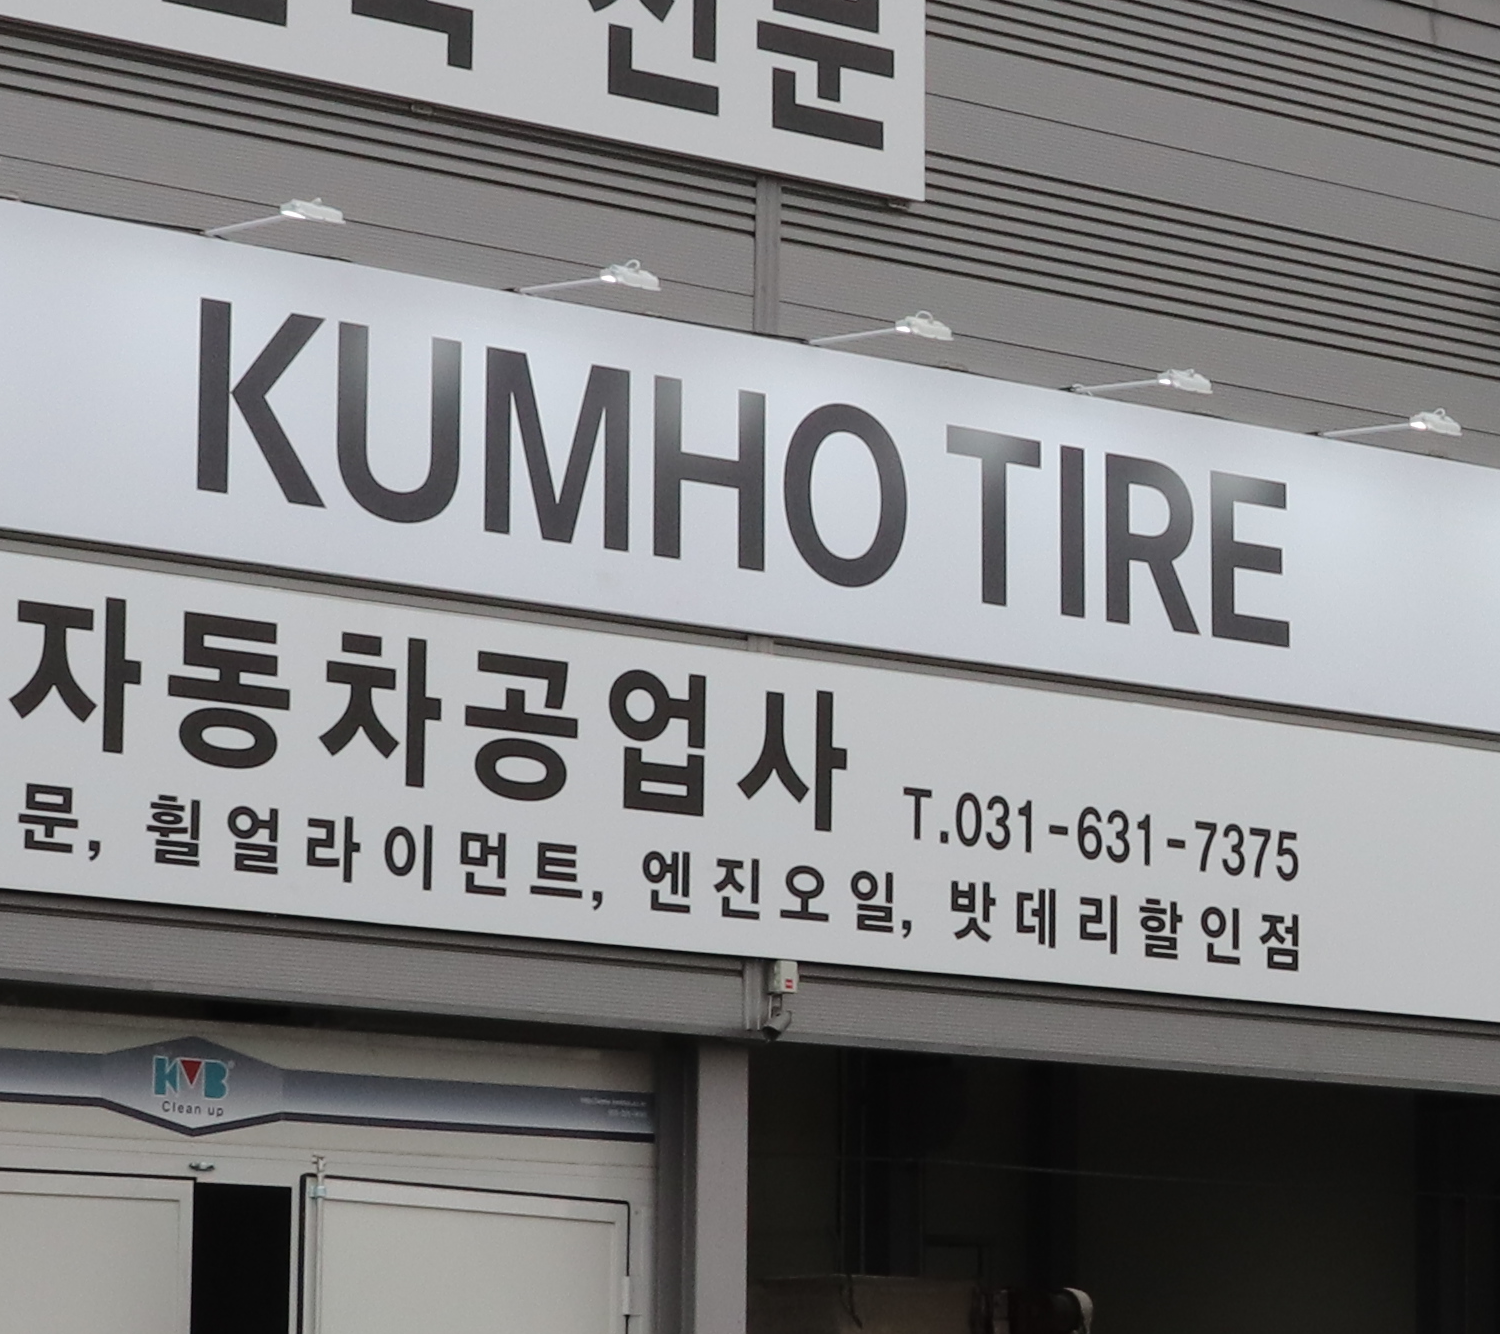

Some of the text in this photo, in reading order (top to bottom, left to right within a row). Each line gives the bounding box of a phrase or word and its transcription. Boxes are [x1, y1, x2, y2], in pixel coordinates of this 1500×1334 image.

[196, 297, 1291, 648] KUMHO TIRE
[903, 785, 1300, 883] T.031-631-7375
[161, 1100, 224, 1117] Clean up
